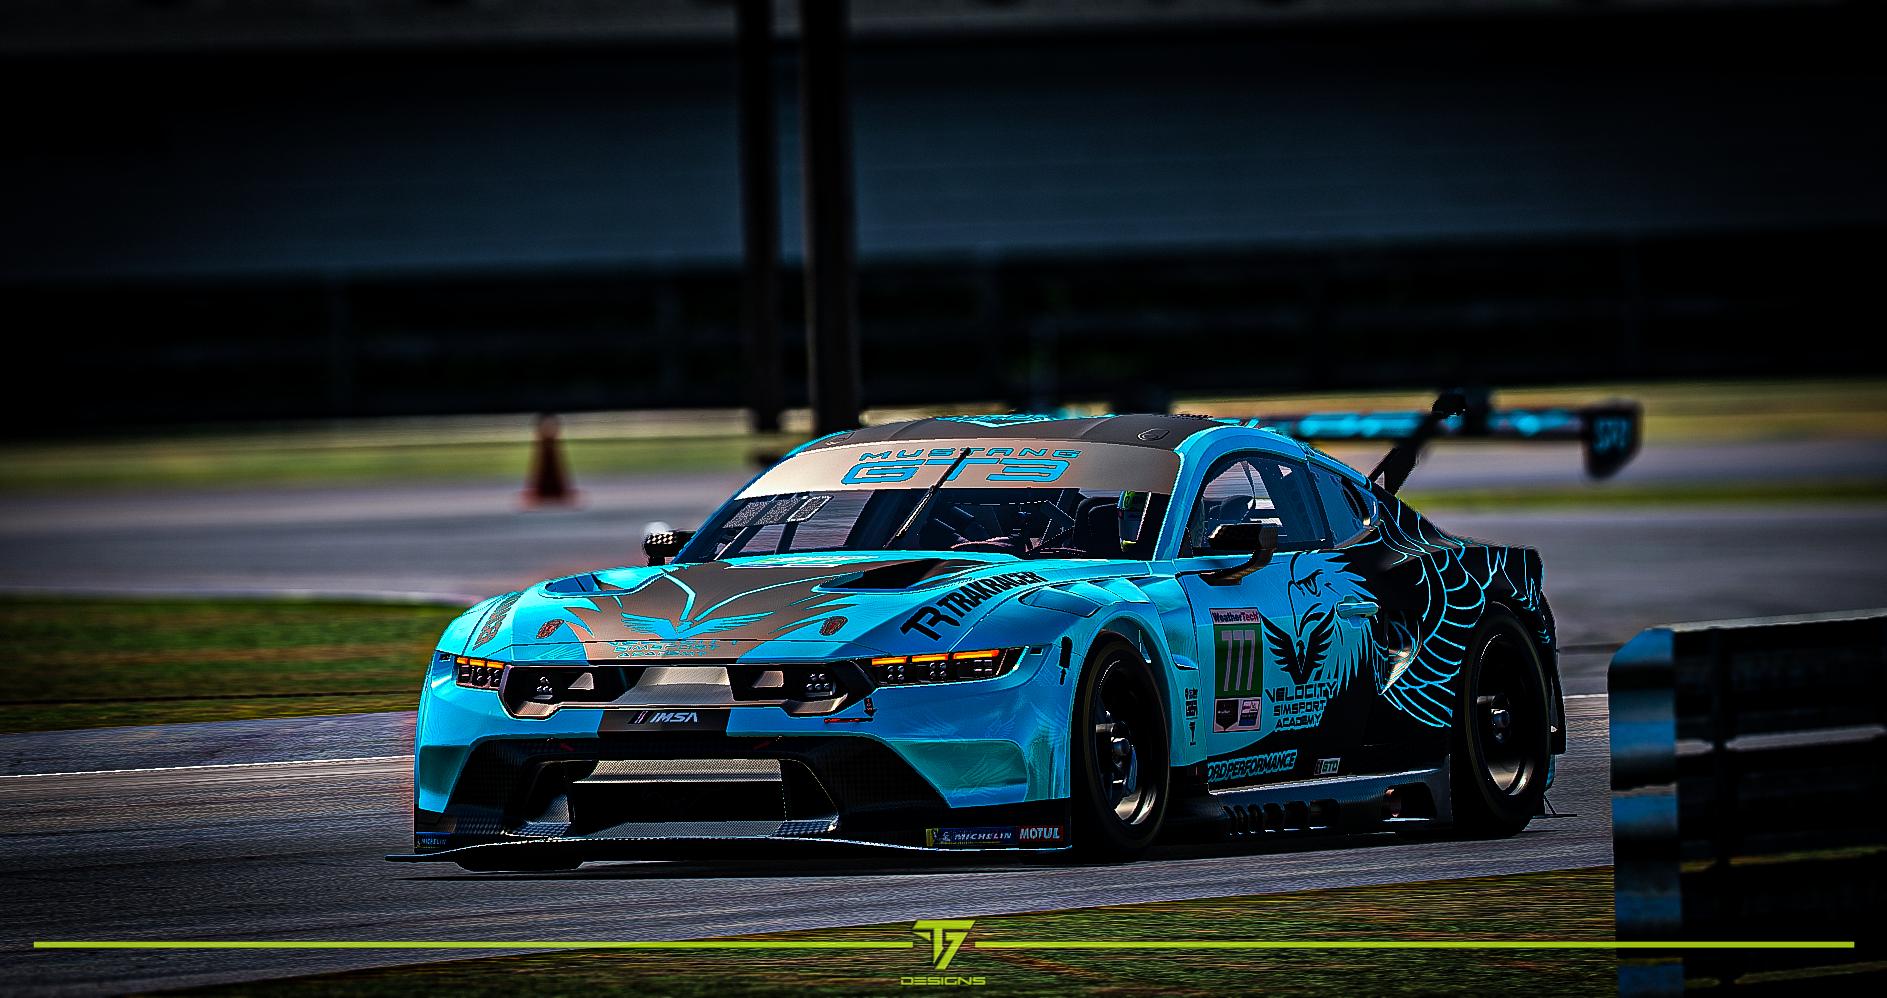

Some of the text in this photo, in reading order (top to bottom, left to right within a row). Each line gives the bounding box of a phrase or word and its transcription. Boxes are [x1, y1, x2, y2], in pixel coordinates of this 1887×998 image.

[858, 447, 1082, 461] MUSTANG
[841, 458, 1070, 485] GT3
[936, 571, 1049, 618] TRAKRACER
[1212, 612, 1259, 622] WeatherTech
[1221, 629, 1256, 692] 777
[1265, 681, 1338, 704] VELOCITY
[1273, 700, 1326, 717] SIMSPORT
[650, 712, 698, 723] IMSA
[1275, 713, 1322, 730] ACADEMY
[954, 831, 1012, 840] MICHELIN
[1020, 827, 1061, 839] MOTUL
